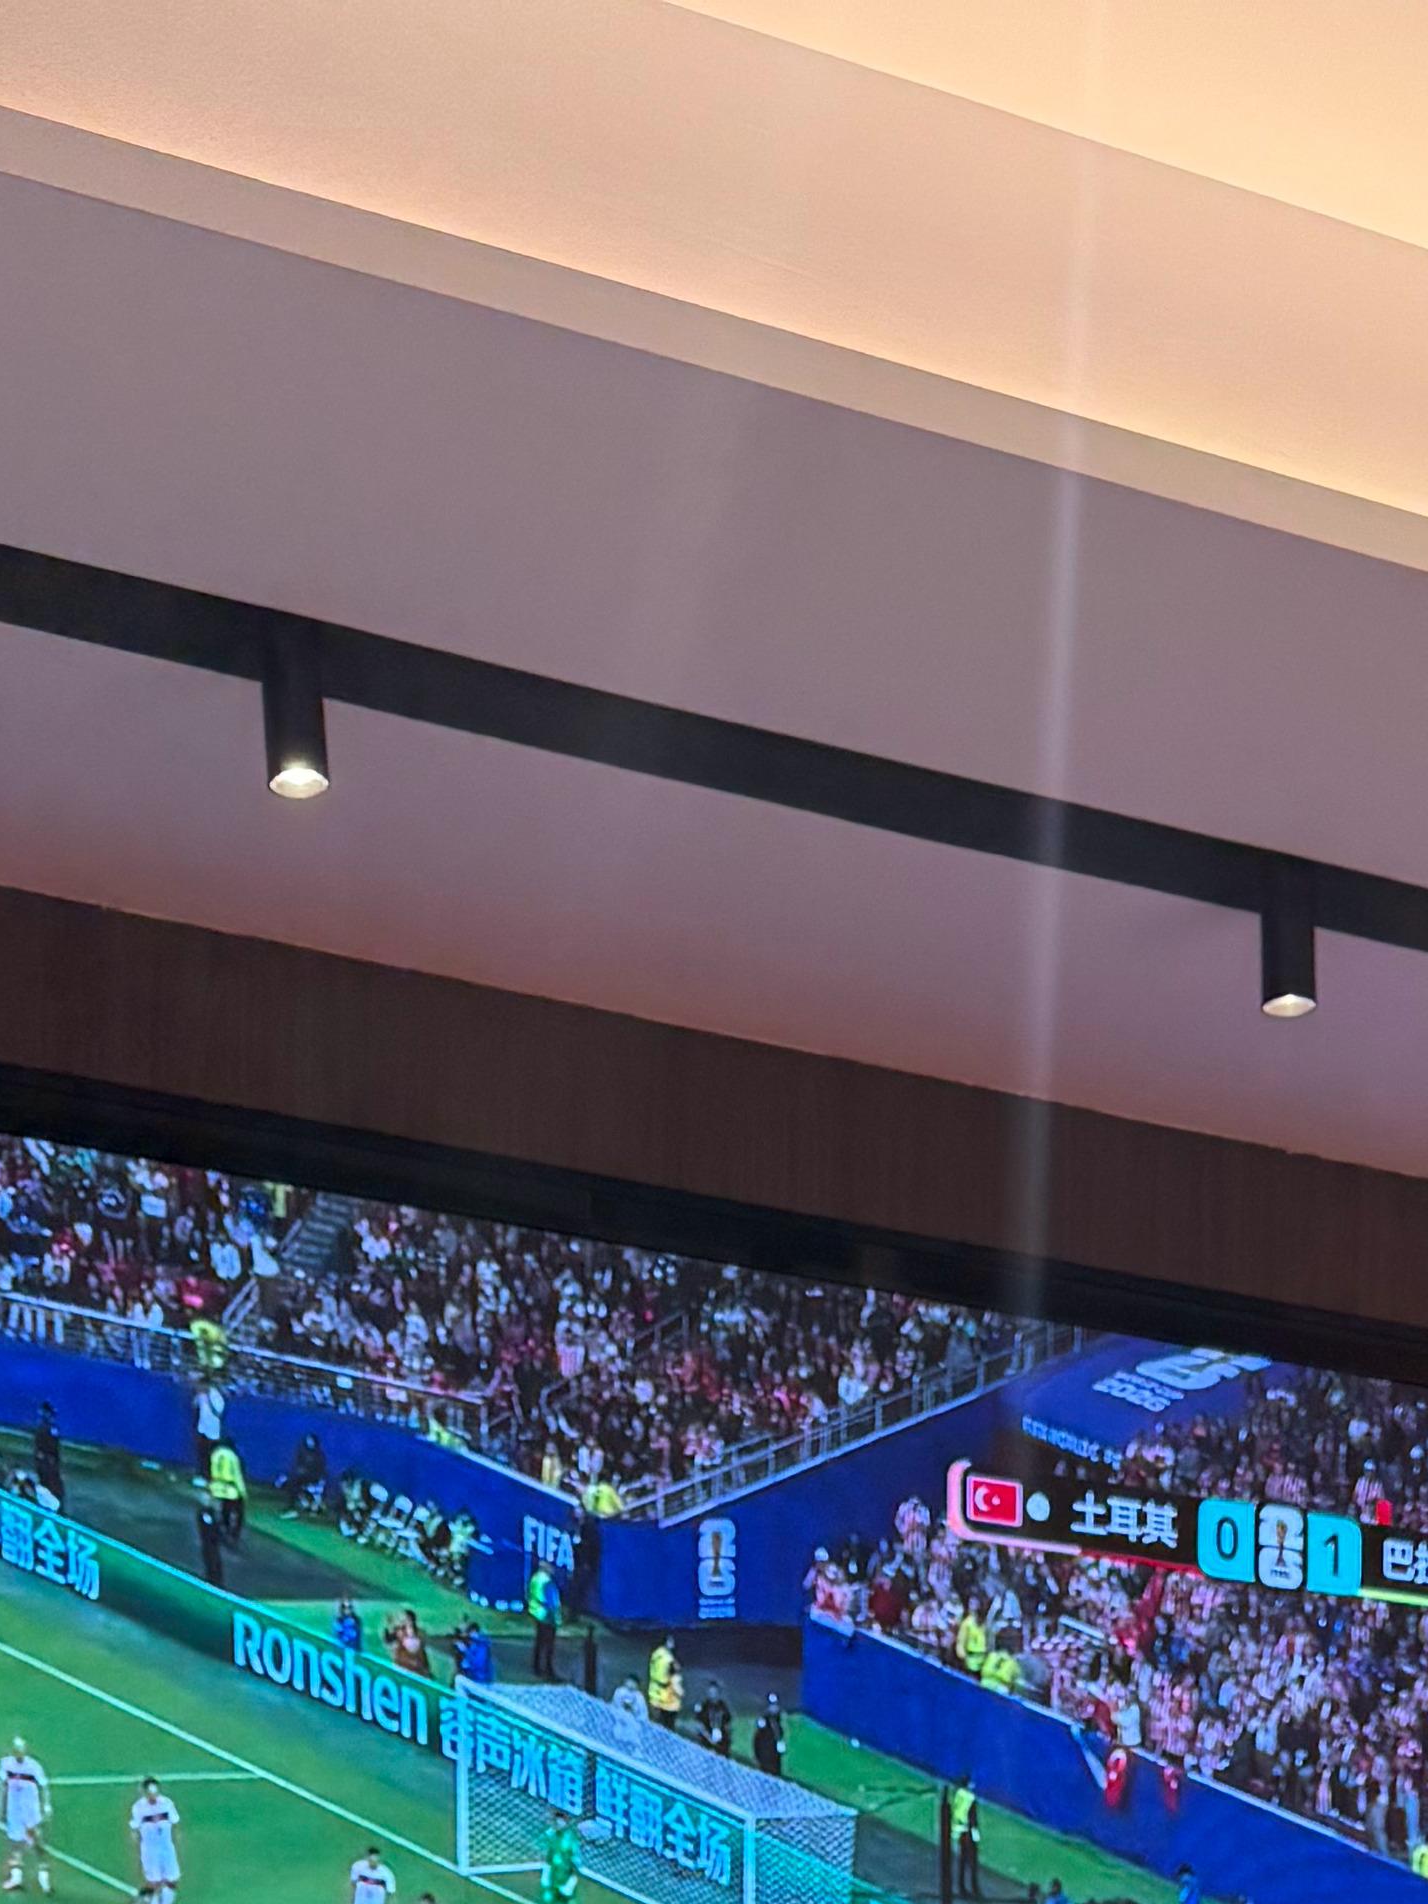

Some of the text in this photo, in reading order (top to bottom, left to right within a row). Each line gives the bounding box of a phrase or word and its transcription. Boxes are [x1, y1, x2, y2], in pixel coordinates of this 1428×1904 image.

[523, 1515, 575, 1573] FIFA
[1070, 1490, 1179, 1548] 土耳其
[1216, 1516, 1239, 1561] 0
[232, 1610, 429, 1746] Ronshen
